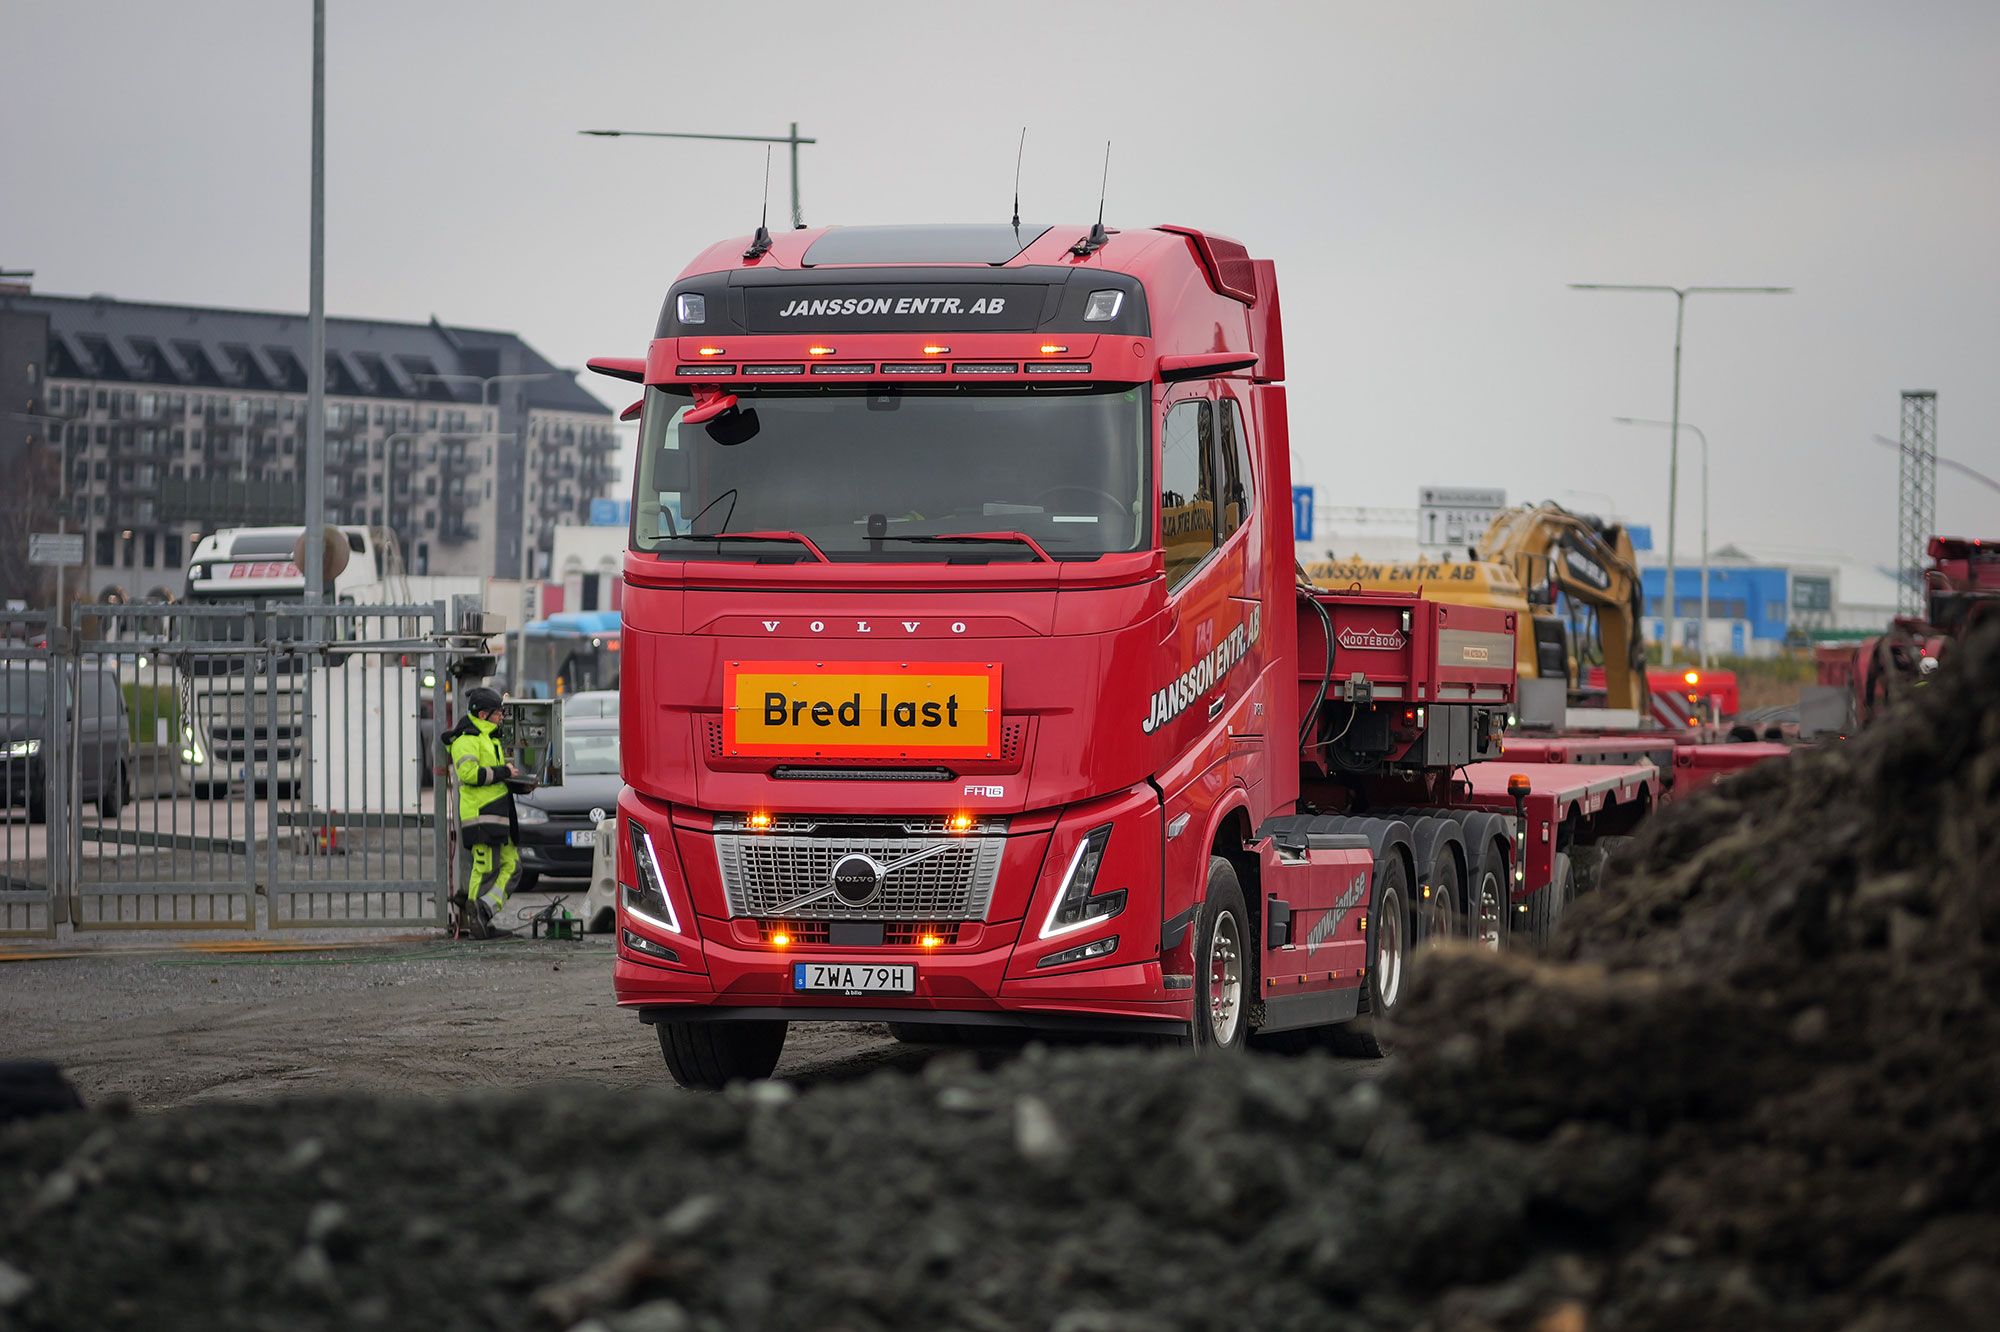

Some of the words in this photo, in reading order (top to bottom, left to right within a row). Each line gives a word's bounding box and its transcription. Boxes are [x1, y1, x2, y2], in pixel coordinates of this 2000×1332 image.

[779, 298, 893, 317] JANSSON
[894, 298, 964, 314] ENTR.
[968, 298, 1005, 314] AB
[1450, 564, 1476, 580] AB
[762, 621, 966, 633] VOLVO
[1343, 635, 1401, 647] NOOTEBOOM
[1142, 650, 1215, 735] JANSSON
[1215, 621, 1246, 681] ENTR.
[1247, 602, 1260, 649] AB
[764, 692, 861, 726] Bred
[880, 693, 959, 727] last
[964, 785, 1004, 797] FH16
[813, 966, 855, 988] ZWA
[862, 967, 904, 989] 79H
